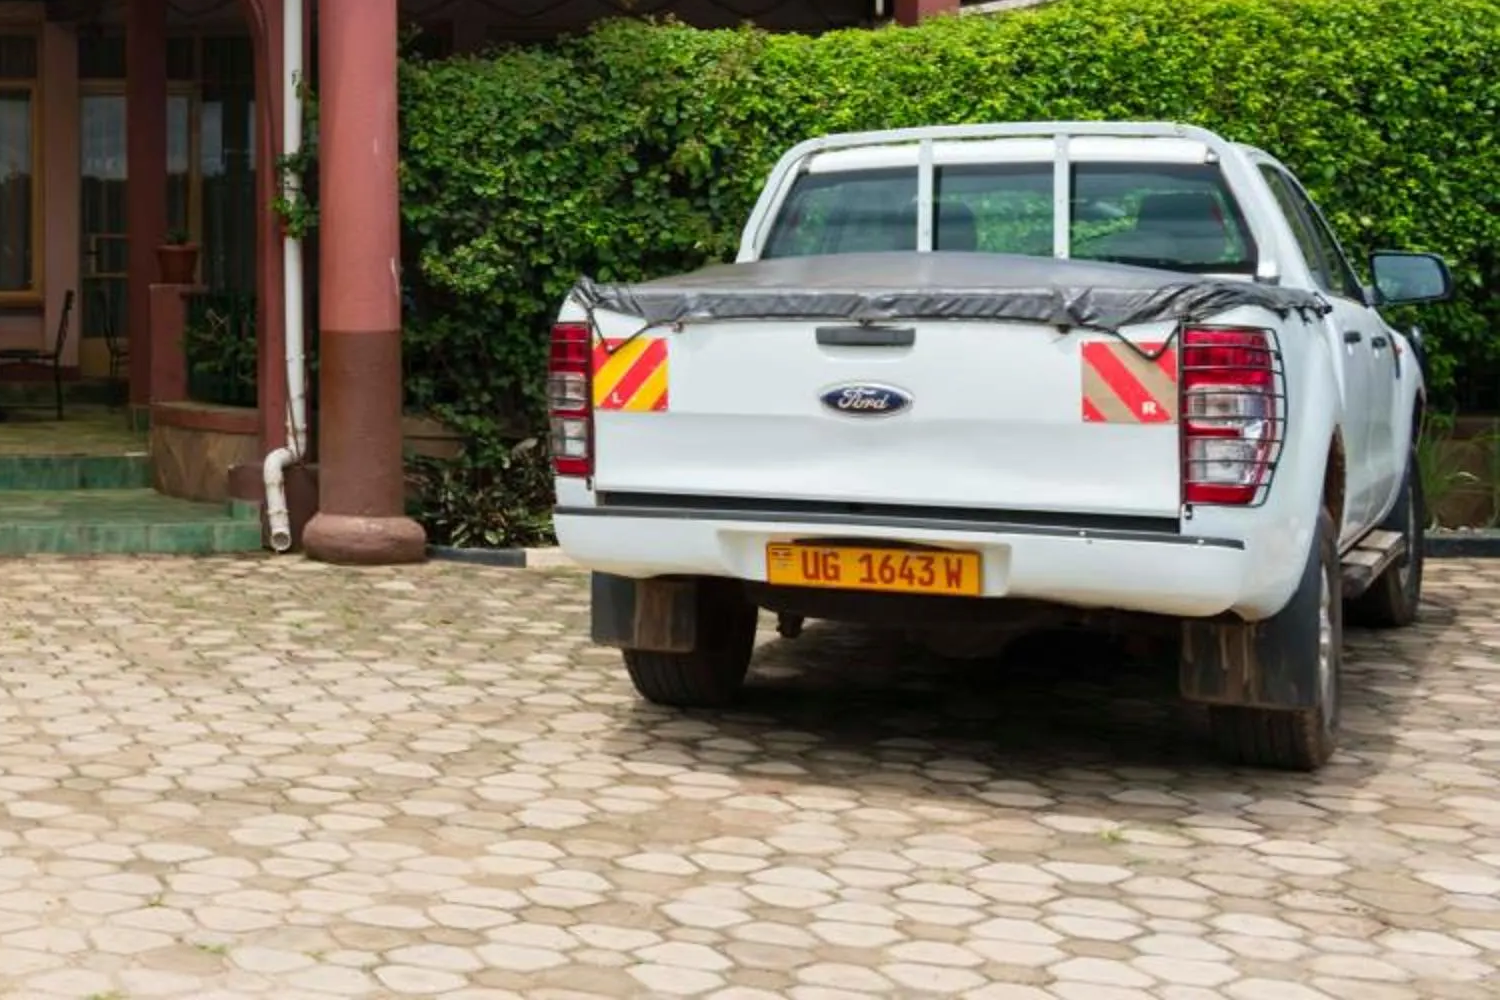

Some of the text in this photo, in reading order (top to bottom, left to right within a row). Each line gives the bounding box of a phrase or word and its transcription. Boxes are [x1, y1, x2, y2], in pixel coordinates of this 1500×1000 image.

[837, 387, 891, 410] Ford
[1141, 400, 1157, 415] R
[801, 549, 963, 589] UG 1643 W
